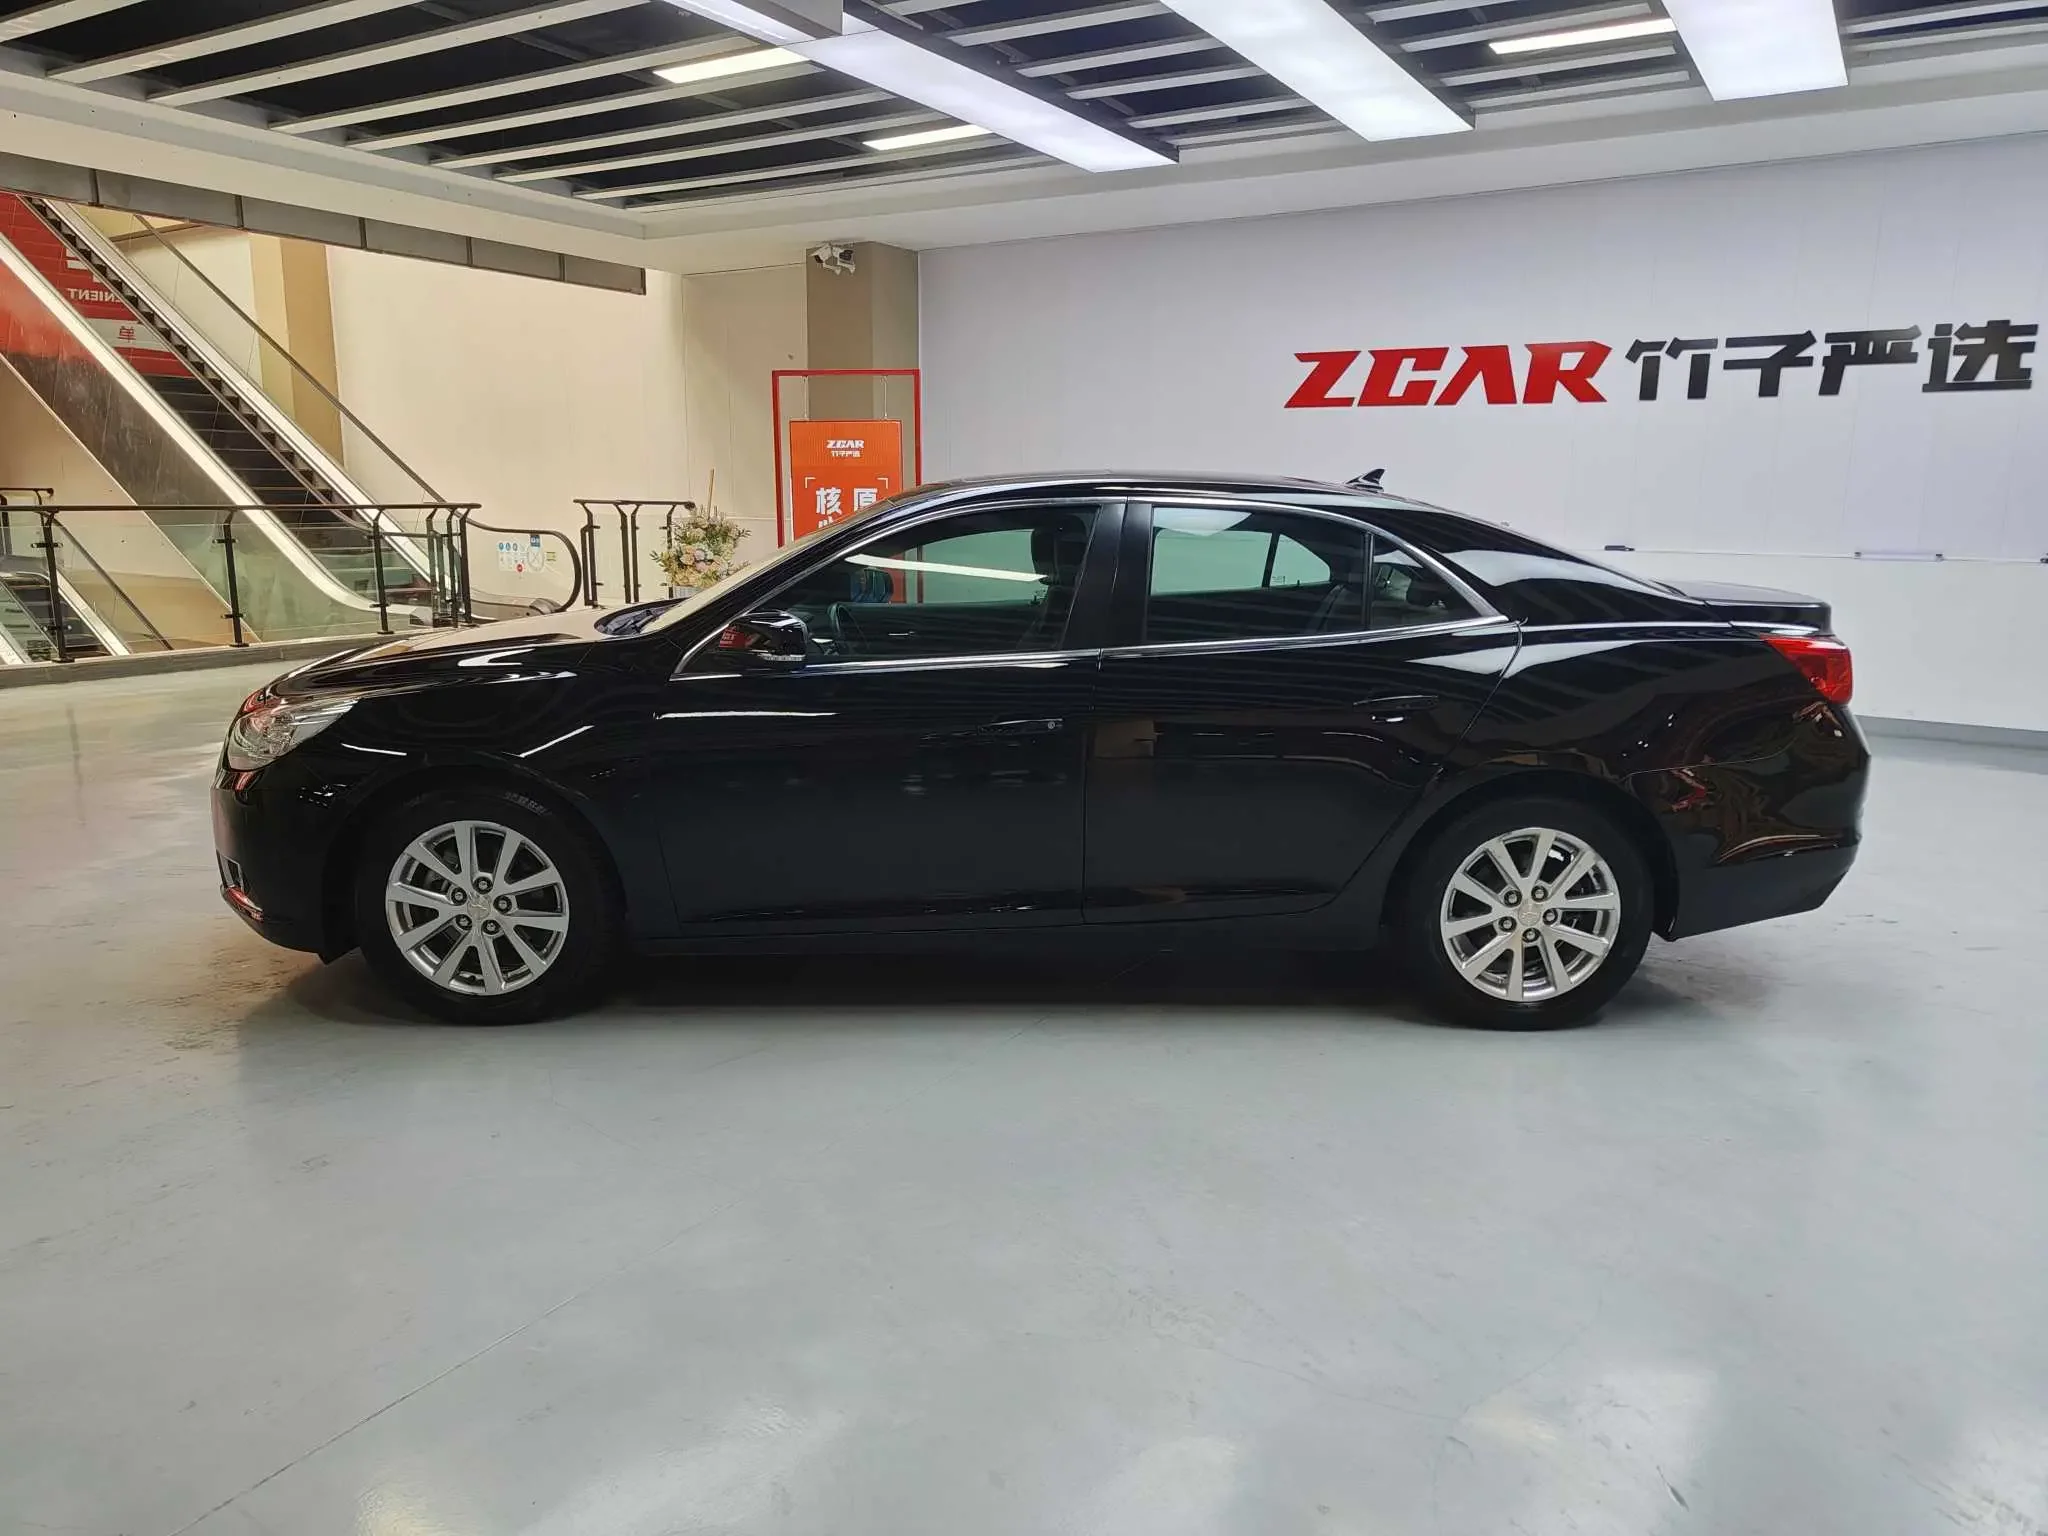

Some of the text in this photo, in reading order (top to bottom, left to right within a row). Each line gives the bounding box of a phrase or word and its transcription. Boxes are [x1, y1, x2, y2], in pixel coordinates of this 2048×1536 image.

[1284, 319, 2040, 409] ZCAR 竹子严选
[826, 439, 865, 449] ZCAR
